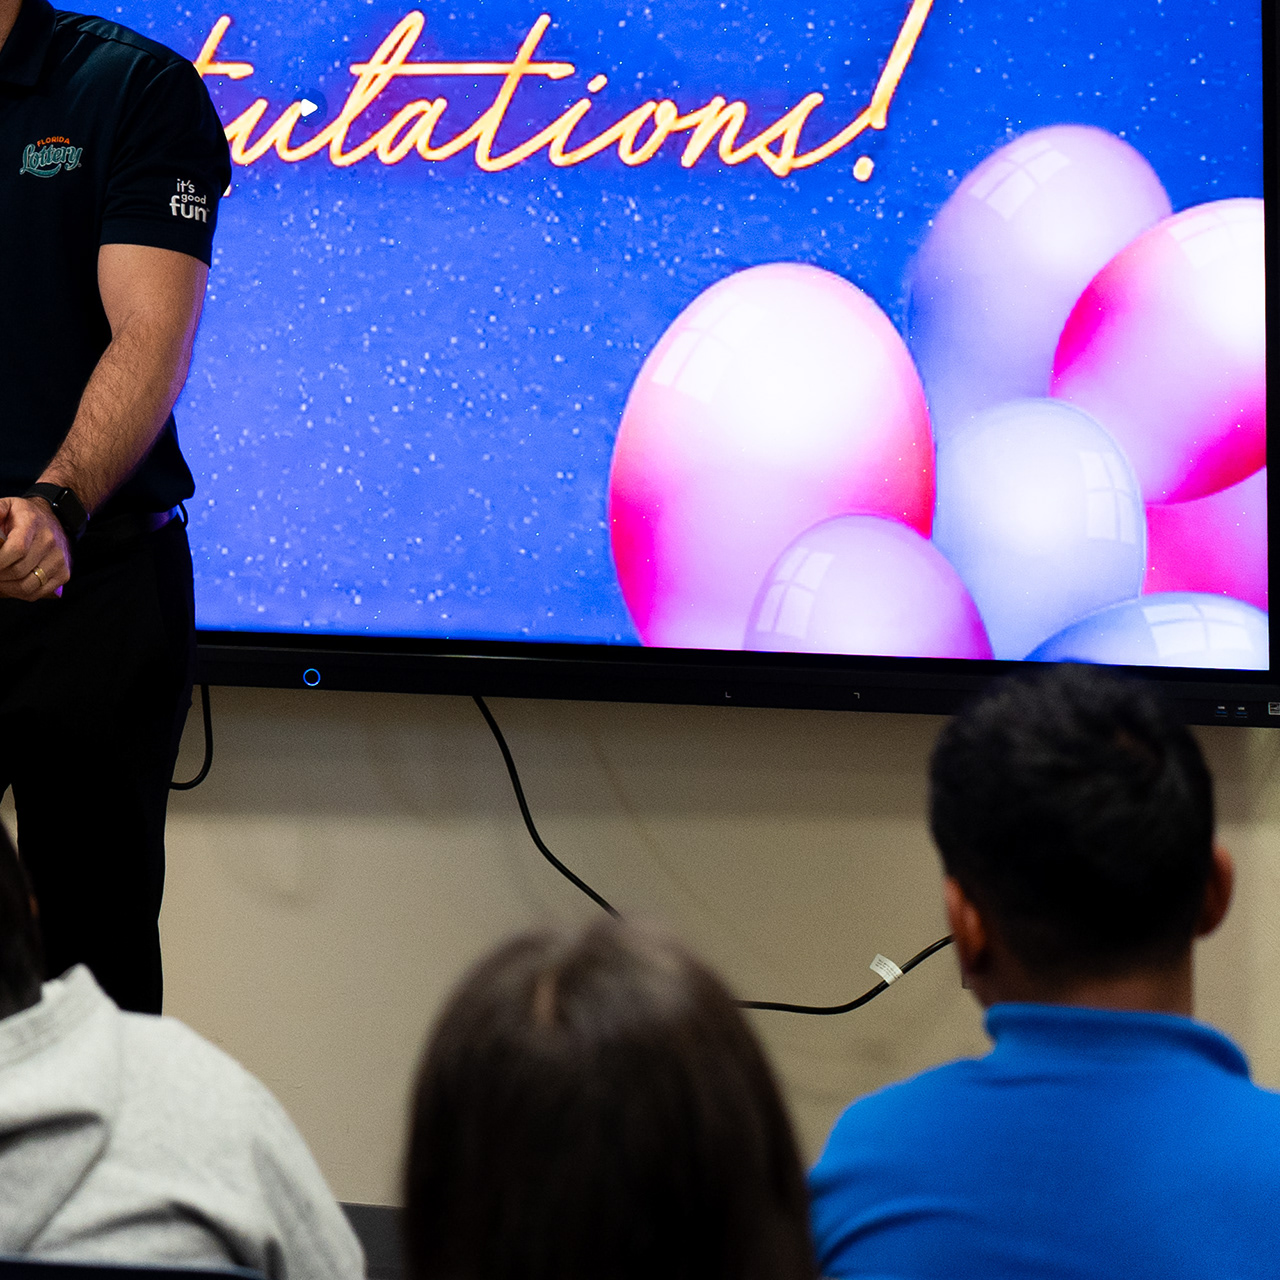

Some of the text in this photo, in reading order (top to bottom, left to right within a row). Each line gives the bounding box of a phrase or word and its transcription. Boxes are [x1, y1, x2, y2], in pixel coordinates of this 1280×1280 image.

[37, 136, 70, 147] FLORIDA
[19, 143, 83, 178] Lottery
[176, 178, 195, 193] it's
[181, 194, 207, 205] good
[169, 195, 207, 223] fun
